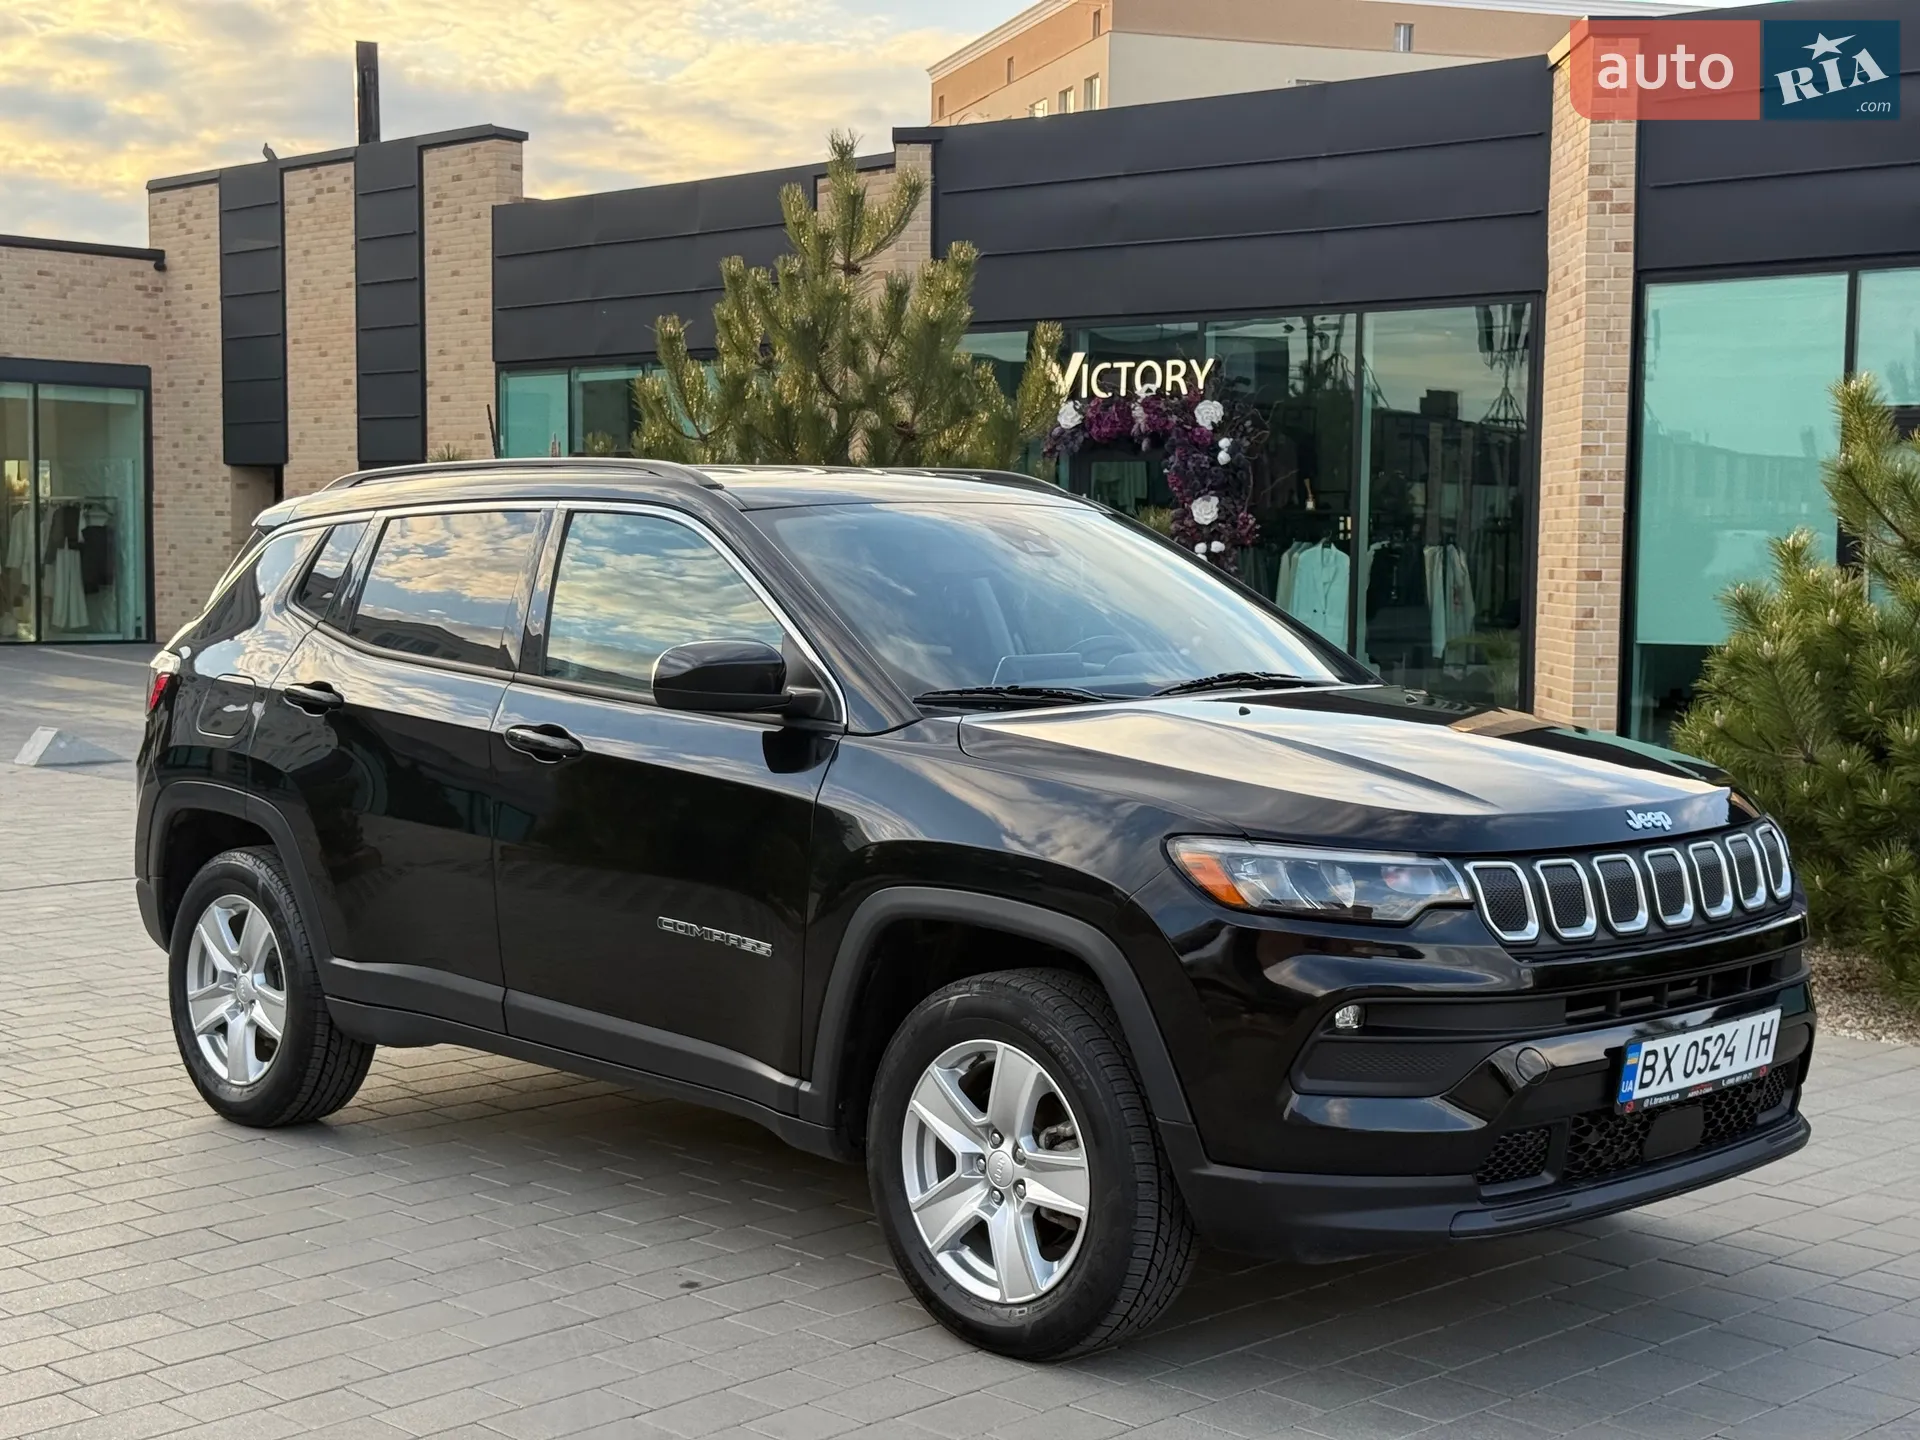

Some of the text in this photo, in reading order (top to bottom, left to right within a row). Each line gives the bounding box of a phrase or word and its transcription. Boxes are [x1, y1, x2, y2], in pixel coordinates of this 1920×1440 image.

[1626, 809, 1672, 831] Jeep
[657, 916, 773, 957] COMPASS
[1638, 1018, 1775, 1090] BX 0524 IH
[1621, 1079, 1633, 1093] UA
